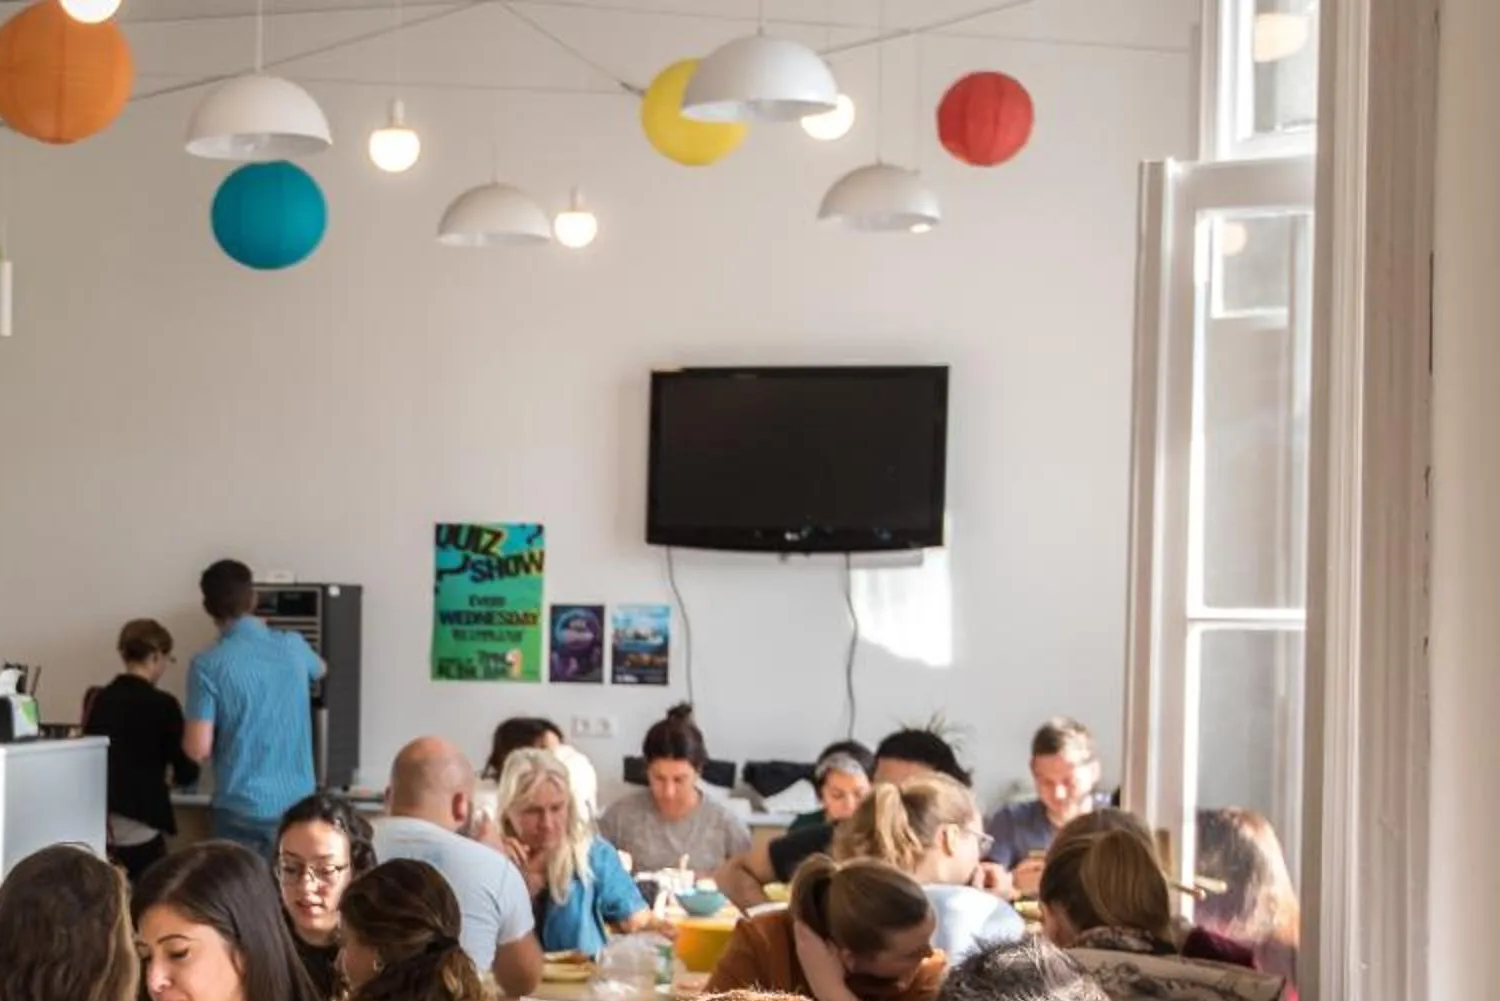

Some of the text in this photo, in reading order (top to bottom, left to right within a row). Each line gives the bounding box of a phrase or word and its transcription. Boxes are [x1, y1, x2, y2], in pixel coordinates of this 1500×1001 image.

[435, 524, 504, 556] QUIZ
[469, 550, 544, 583] SHOW
[439, 610, 539, 627] WEDNESDAY
